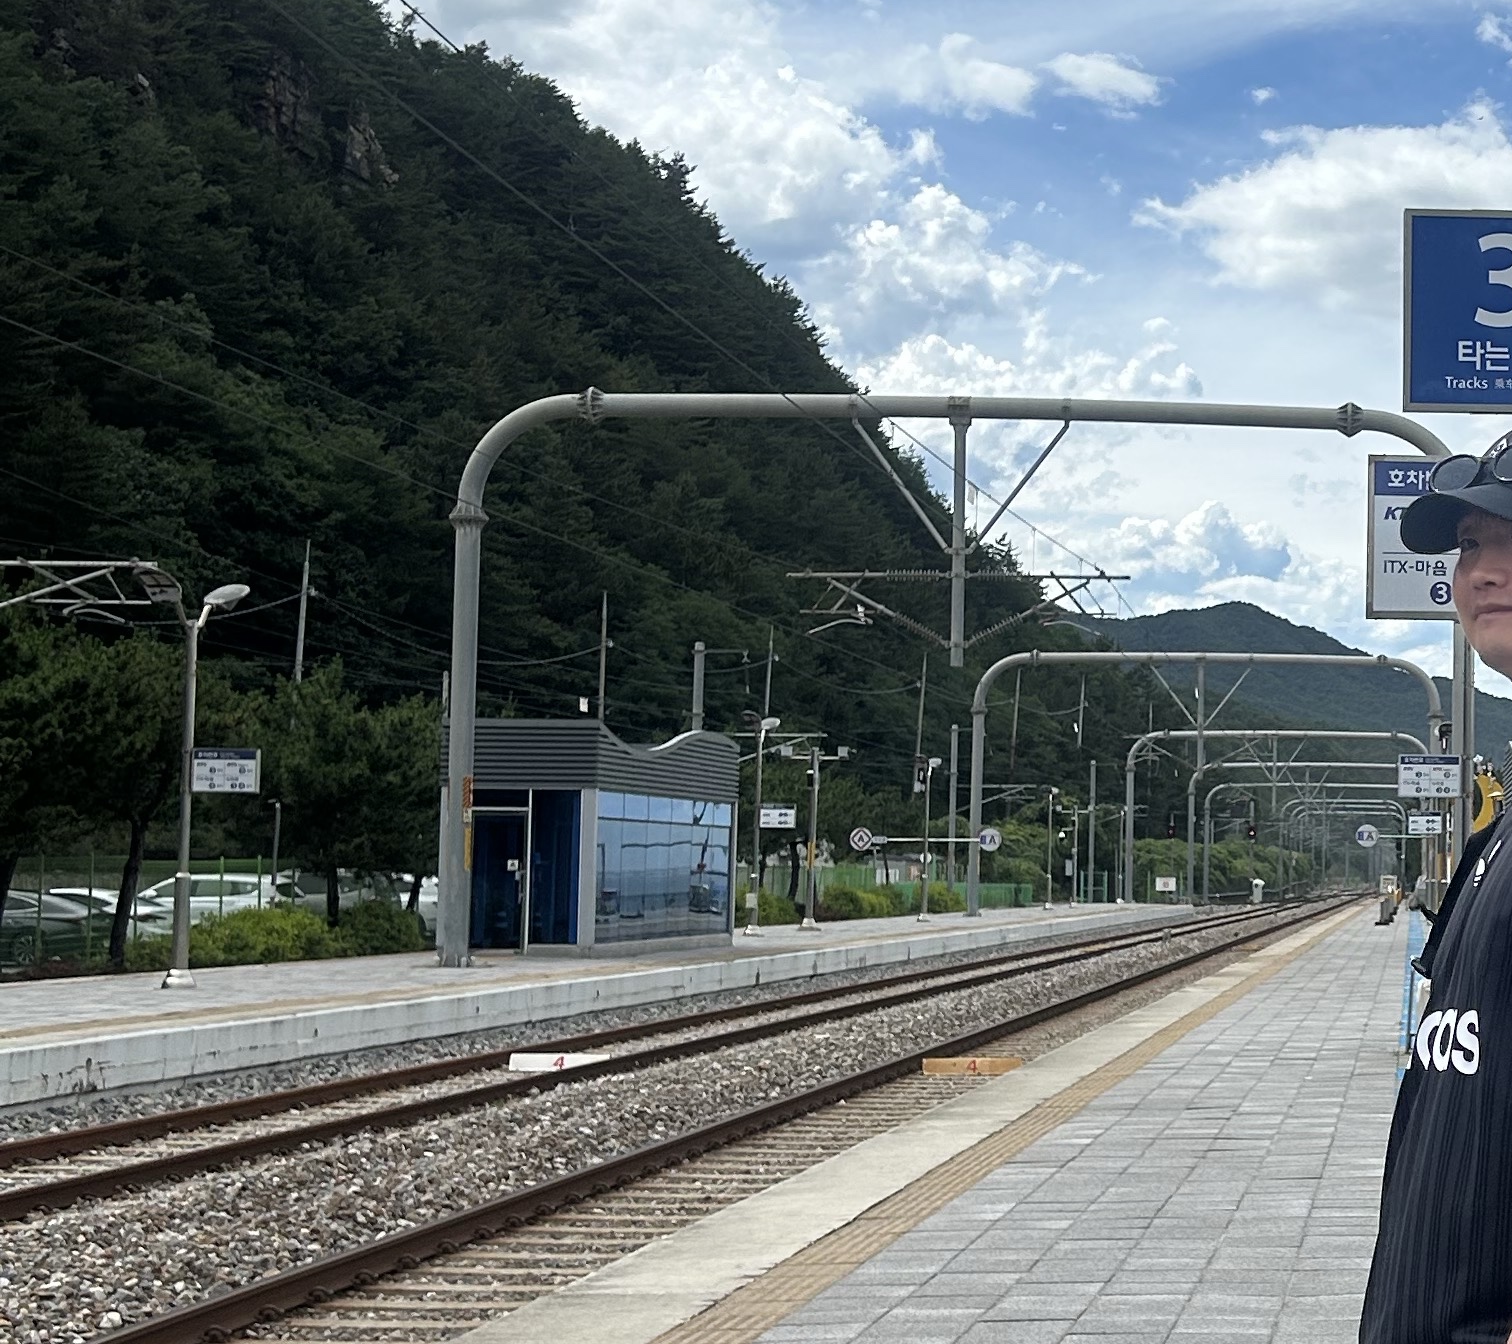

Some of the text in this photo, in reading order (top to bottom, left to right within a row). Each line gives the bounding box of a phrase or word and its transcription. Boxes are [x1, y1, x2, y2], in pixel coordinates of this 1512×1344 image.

[1457, 340, 1510, 371] 타는
[1445, 376, 1488, 389] Tracks
[1383, 560, 1448, 577] ITX-마음
[1434, 583, 1448, 603] 3
[966, 1059, 978, 1073] 4
